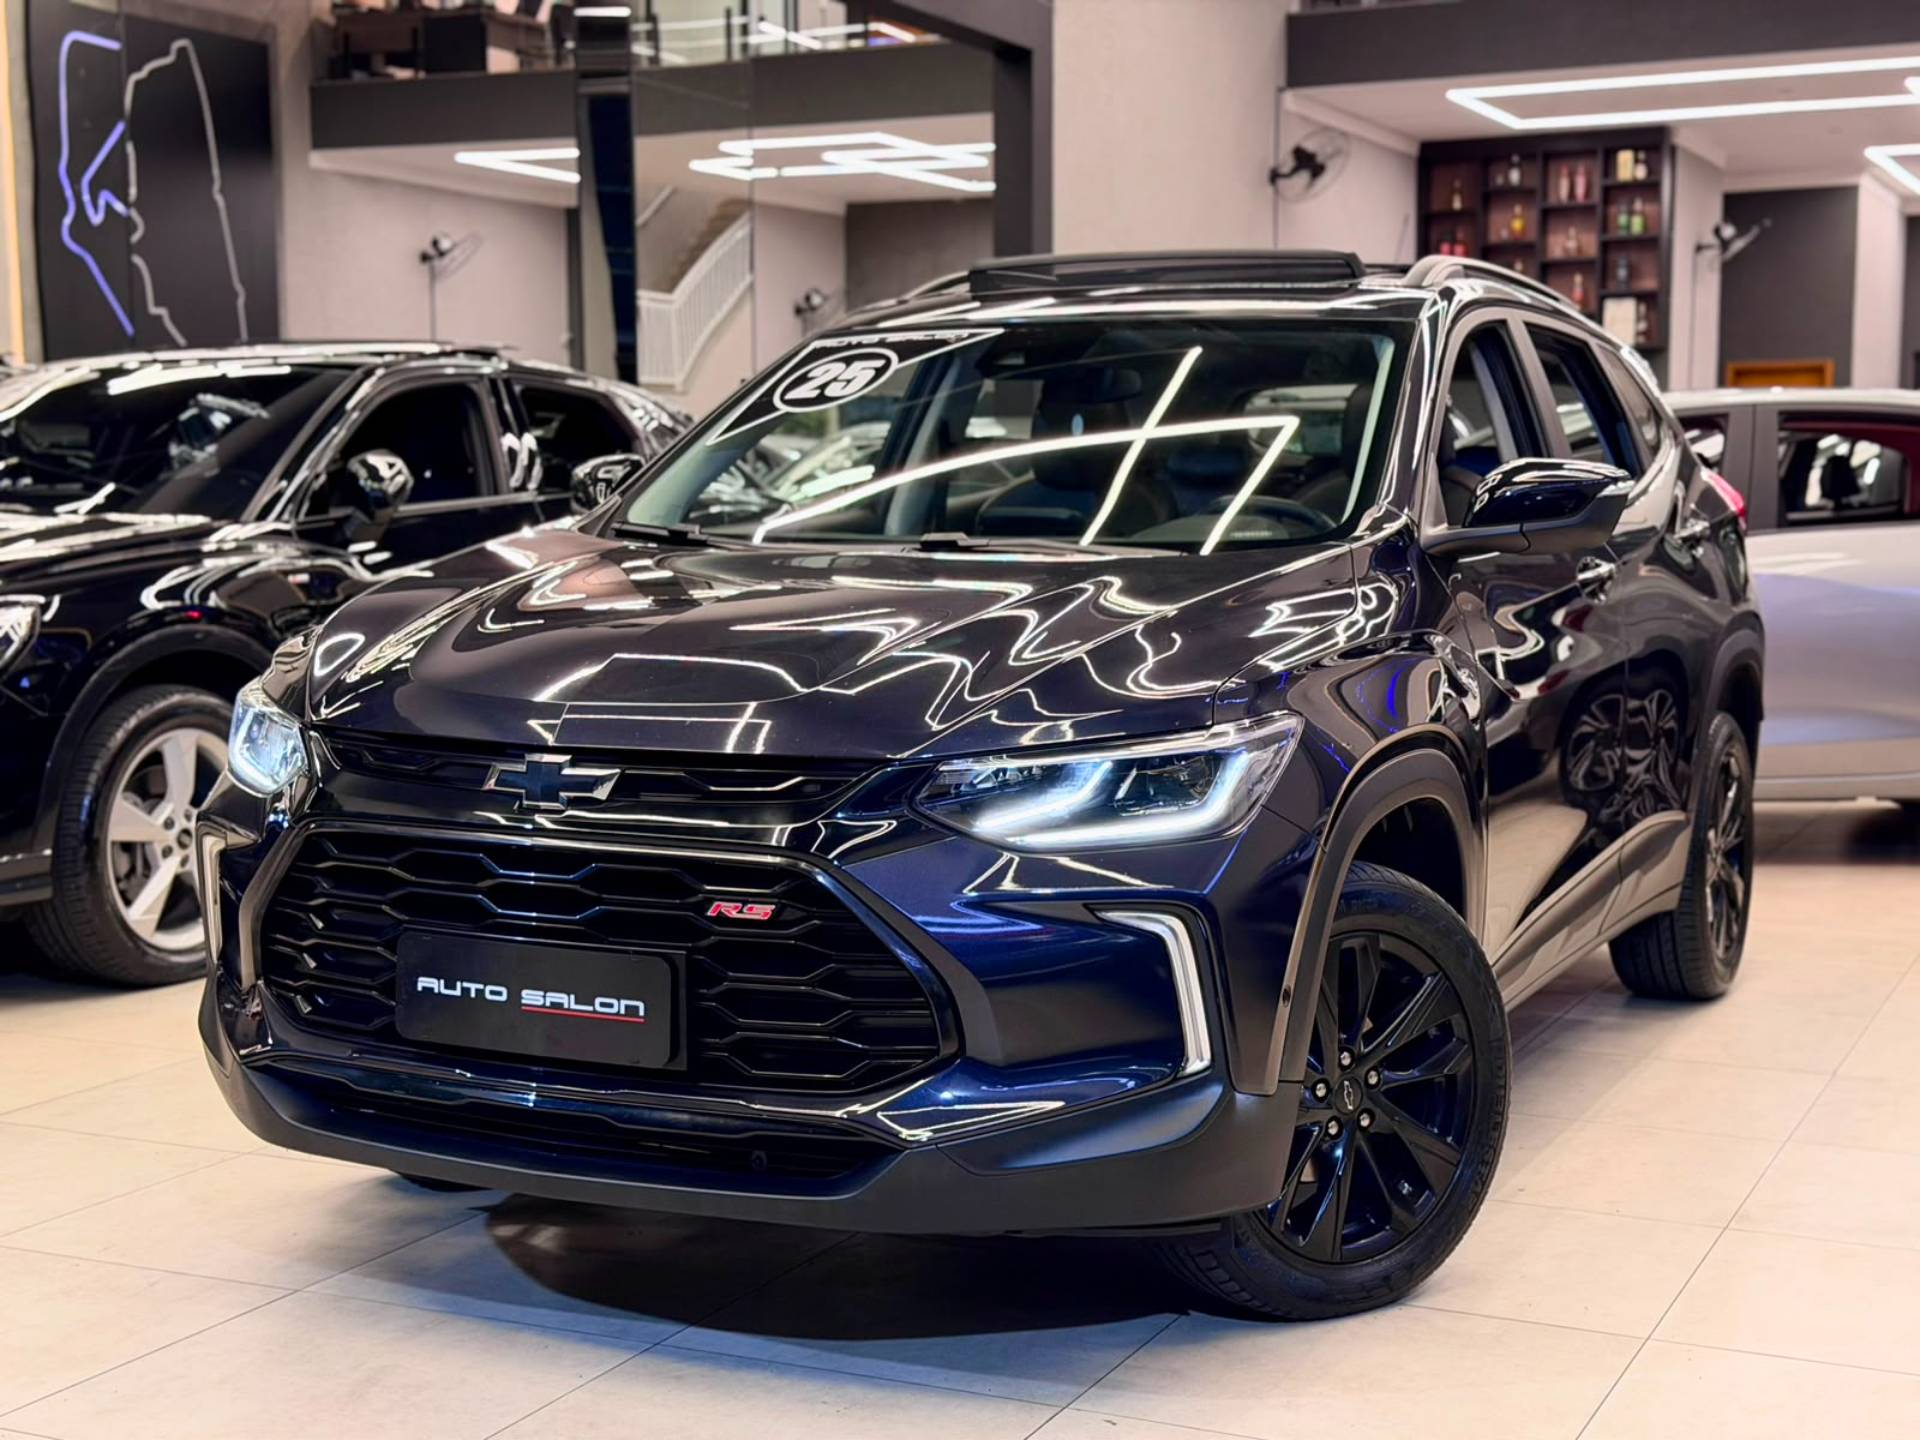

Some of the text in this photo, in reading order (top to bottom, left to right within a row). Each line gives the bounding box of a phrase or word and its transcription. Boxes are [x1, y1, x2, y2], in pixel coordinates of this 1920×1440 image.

[784, 360, 886, 399] 25
[707, 901, 775, 920] RS
[417, 976, 645, 1017] AUTO SALON
